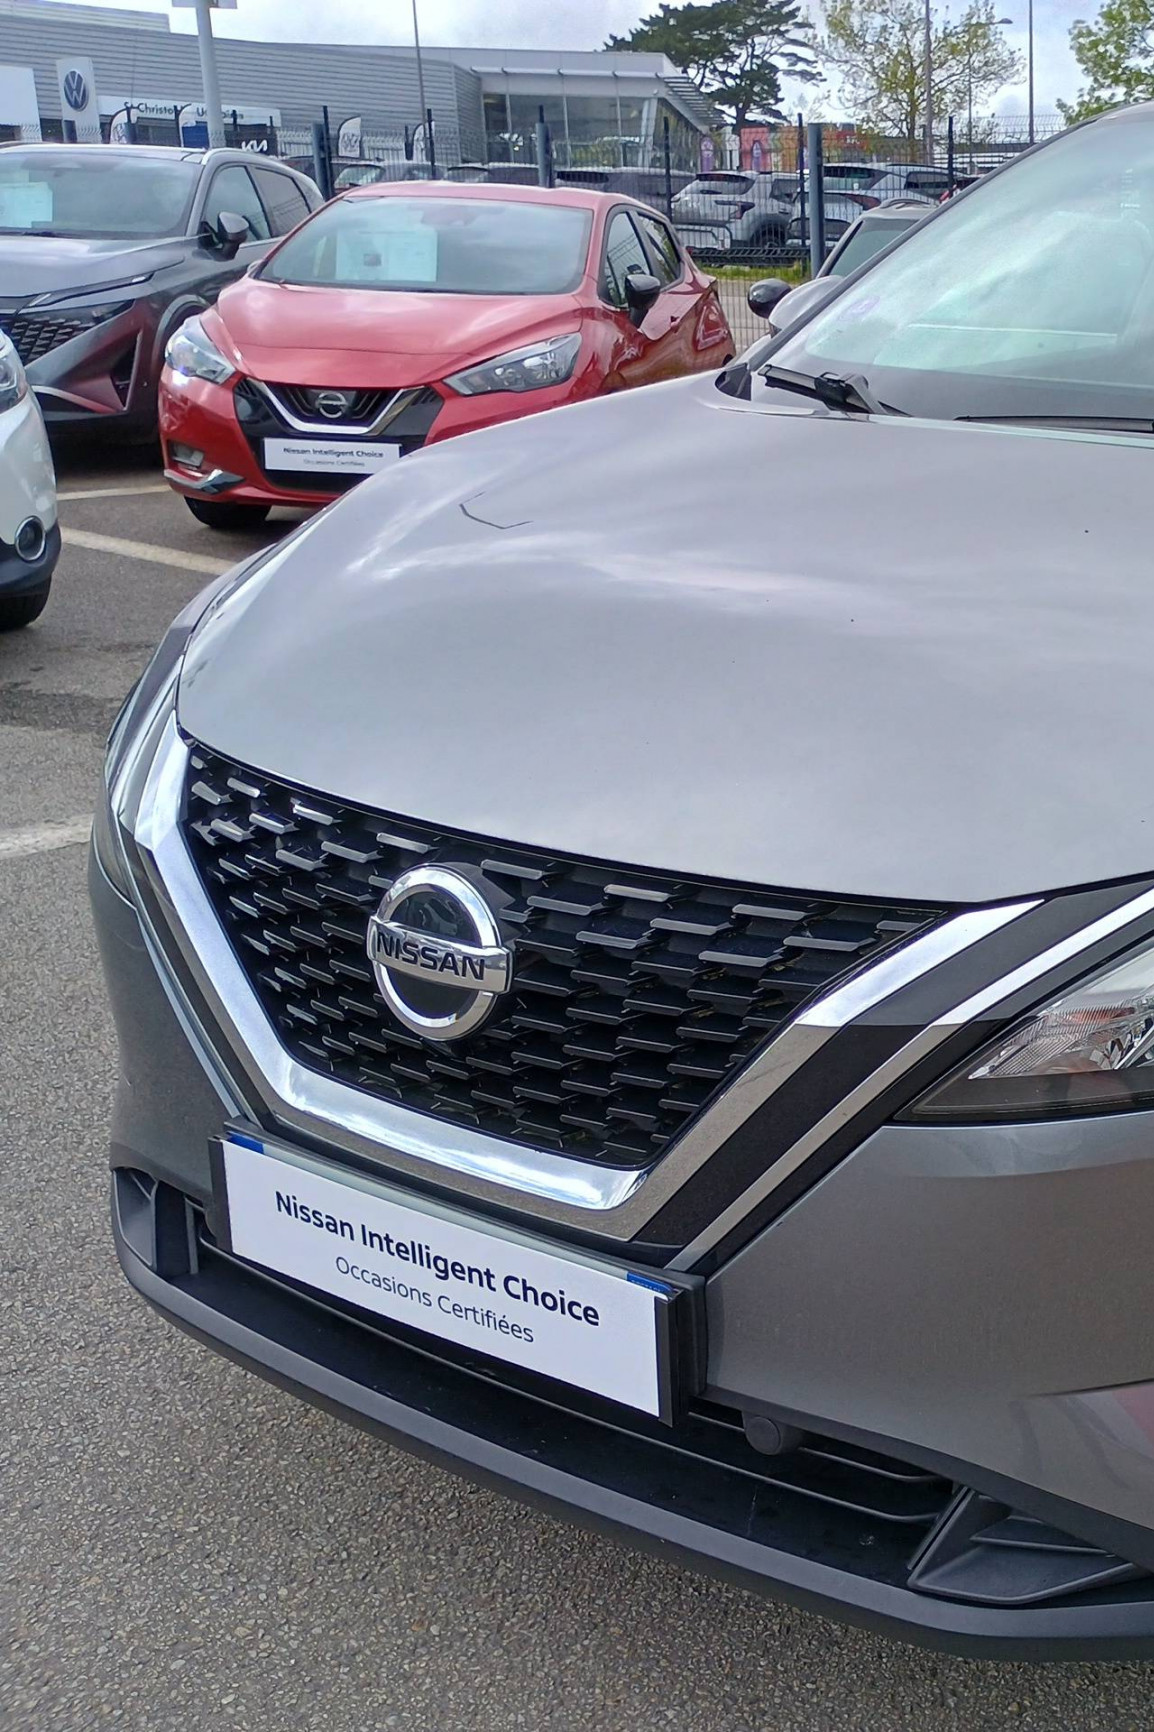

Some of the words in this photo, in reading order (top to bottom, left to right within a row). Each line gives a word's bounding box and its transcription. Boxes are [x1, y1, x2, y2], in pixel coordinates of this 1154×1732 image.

[283, 447, 311, 455] Nissan
[312, 448, 355, 458] Intelligent
[356, 449, 384, 458] Choice
[377, 931, 485, 981] NISSAN
[275, 1191, 355, 1241] Nissan
[361, 1223, 497, 1292] Intelligent
[503, 1275, 600, 1327] Choice
[335, 1256, 433, 1307] Occasions
[438, 1295, 534, 1344] Certifiées
